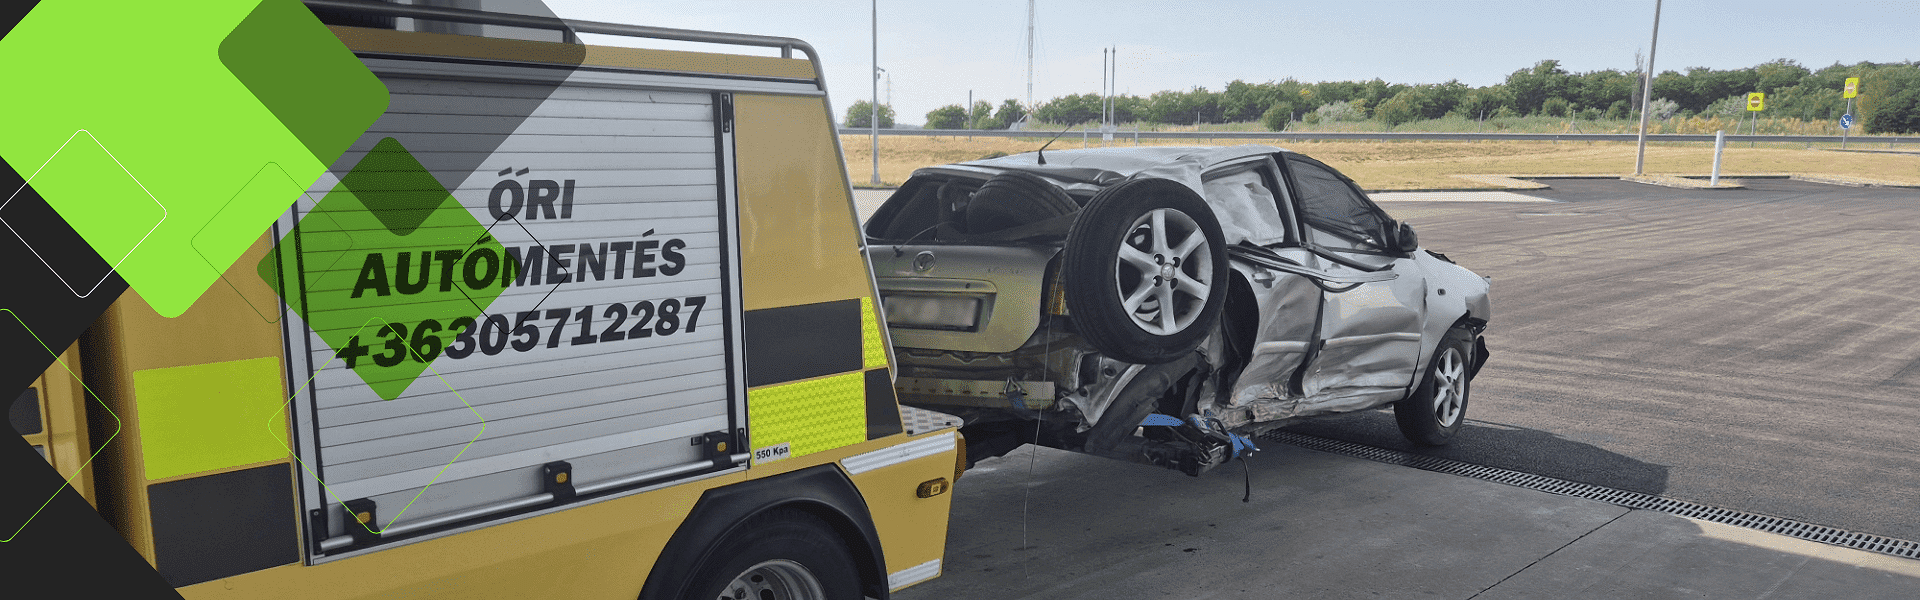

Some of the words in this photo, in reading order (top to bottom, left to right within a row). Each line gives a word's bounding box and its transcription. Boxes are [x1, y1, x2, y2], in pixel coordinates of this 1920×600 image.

[488, 167, 575, 221] ŐRI
[351, 228, 686, 299] AUTÓMENTÉS
[335, 296, 706, 369] +36305712287
[756, 449, 771, 460] 550
[773, 446, 788, 456] Kpa
